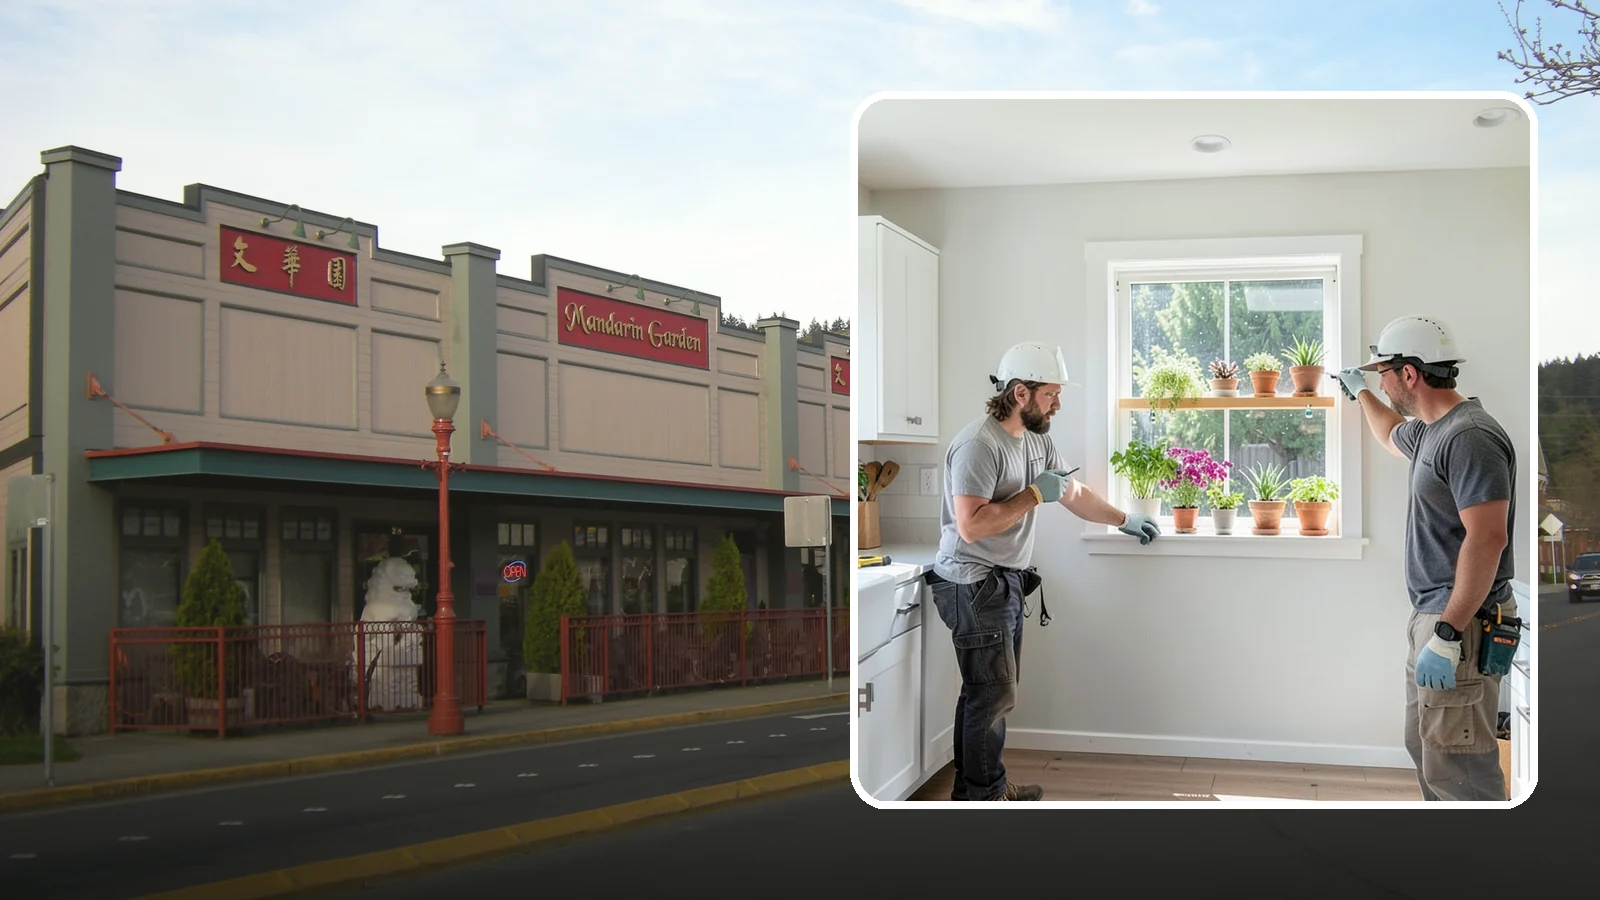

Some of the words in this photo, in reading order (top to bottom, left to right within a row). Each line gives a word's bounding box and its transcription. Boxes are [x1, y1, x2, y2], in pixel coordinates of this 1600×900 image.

[564, 302, 644, 341] Mandarin
[648, 320, 701, 352] Garden
[503, 565, 527, 578] OPEN
